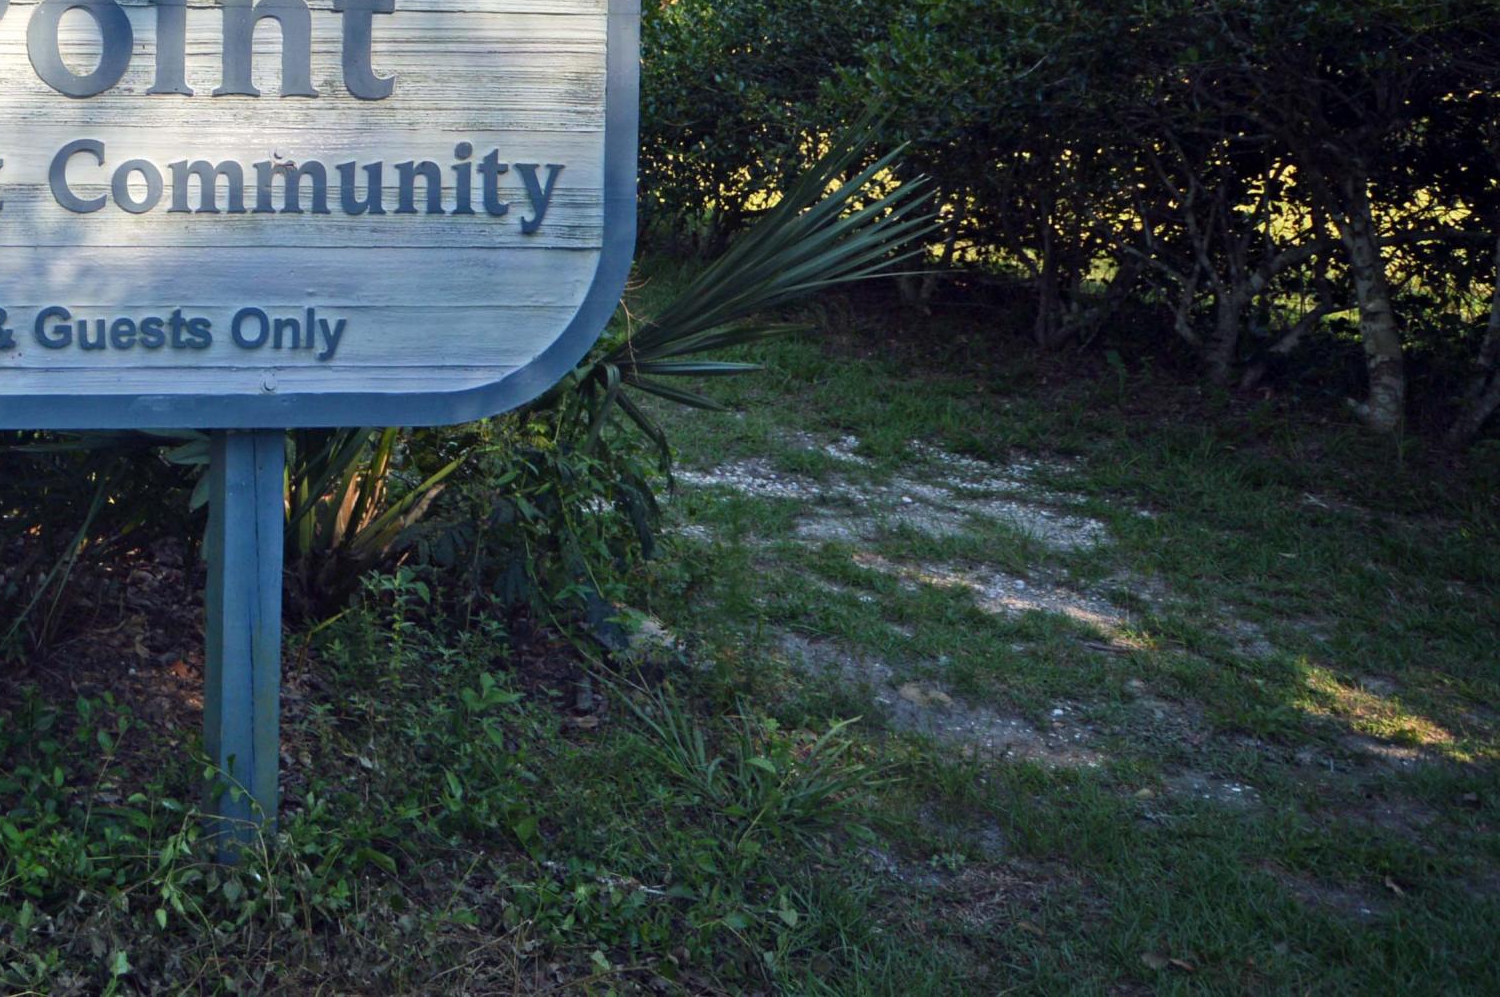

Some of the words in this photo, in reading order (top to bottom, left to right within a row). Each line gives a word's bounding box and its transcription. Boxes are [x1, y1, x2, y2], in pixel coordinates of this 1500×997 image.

[48, 138, 566, 235] Community
[34, 305, 213, 351] Guests
[231, 306, 347, 362] Only
